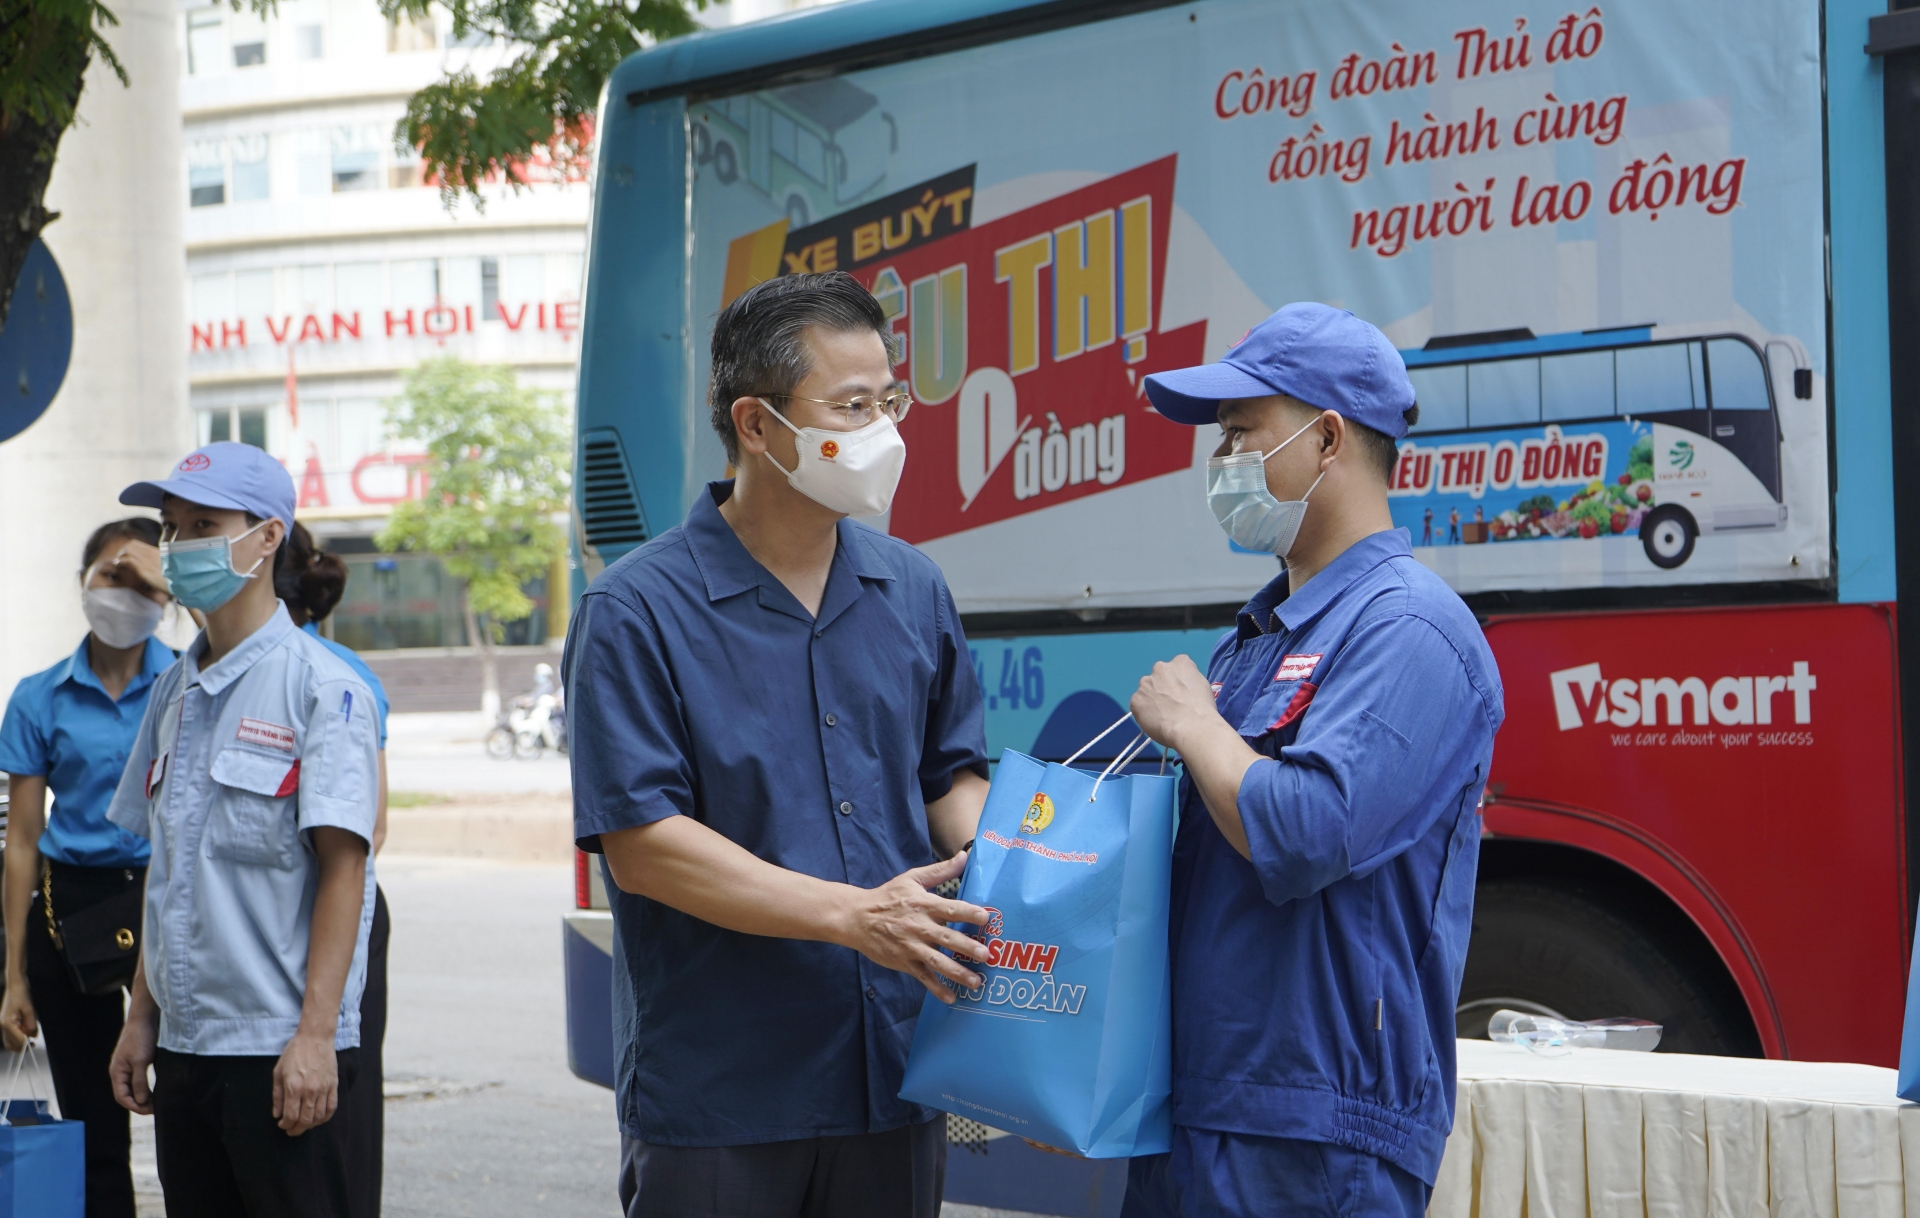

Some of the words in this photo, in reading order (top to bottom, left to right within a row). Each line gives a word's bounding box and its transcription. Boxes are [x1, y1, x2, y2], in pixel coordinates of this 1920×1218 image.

[1215, 67, 1317, 119] Công
[1330, 42, 1439, 100] đoàn
[1454, 17, 1532, 80] Thủ
[1544, 6, 1603, 63] đô
[1267, 122, 1371, 183] đồng
[1384, 106, 1501, 166] hành
[1513, 92, 1627, 146] cùng
[784, 236, 838, 274] XE
[853, 188, 972, 262] BUÝT
[1350, 177, 1496, 258] người
[1510, 176, 1592, 228] lao
[1608, 152, 1746, 221] động
[995, 195, 1153, 378] THỊ
[1013, 412, 1126, 501] đồng
[1441, 450, 1486, 493] THỊ
[1522, 431, 1603, 482] ĐỒNG
[1610, 733, 1631, 747] we
[1636, 732, 1667, 746] care
[1672, 729, 1716, 746] about
[1720, 733, 1752, 749] your
[1757, 731, 1814, 746] success
[985, 937, 1060, 974] SINH
[988, 975, 1087, 1014] ĐOÀN
